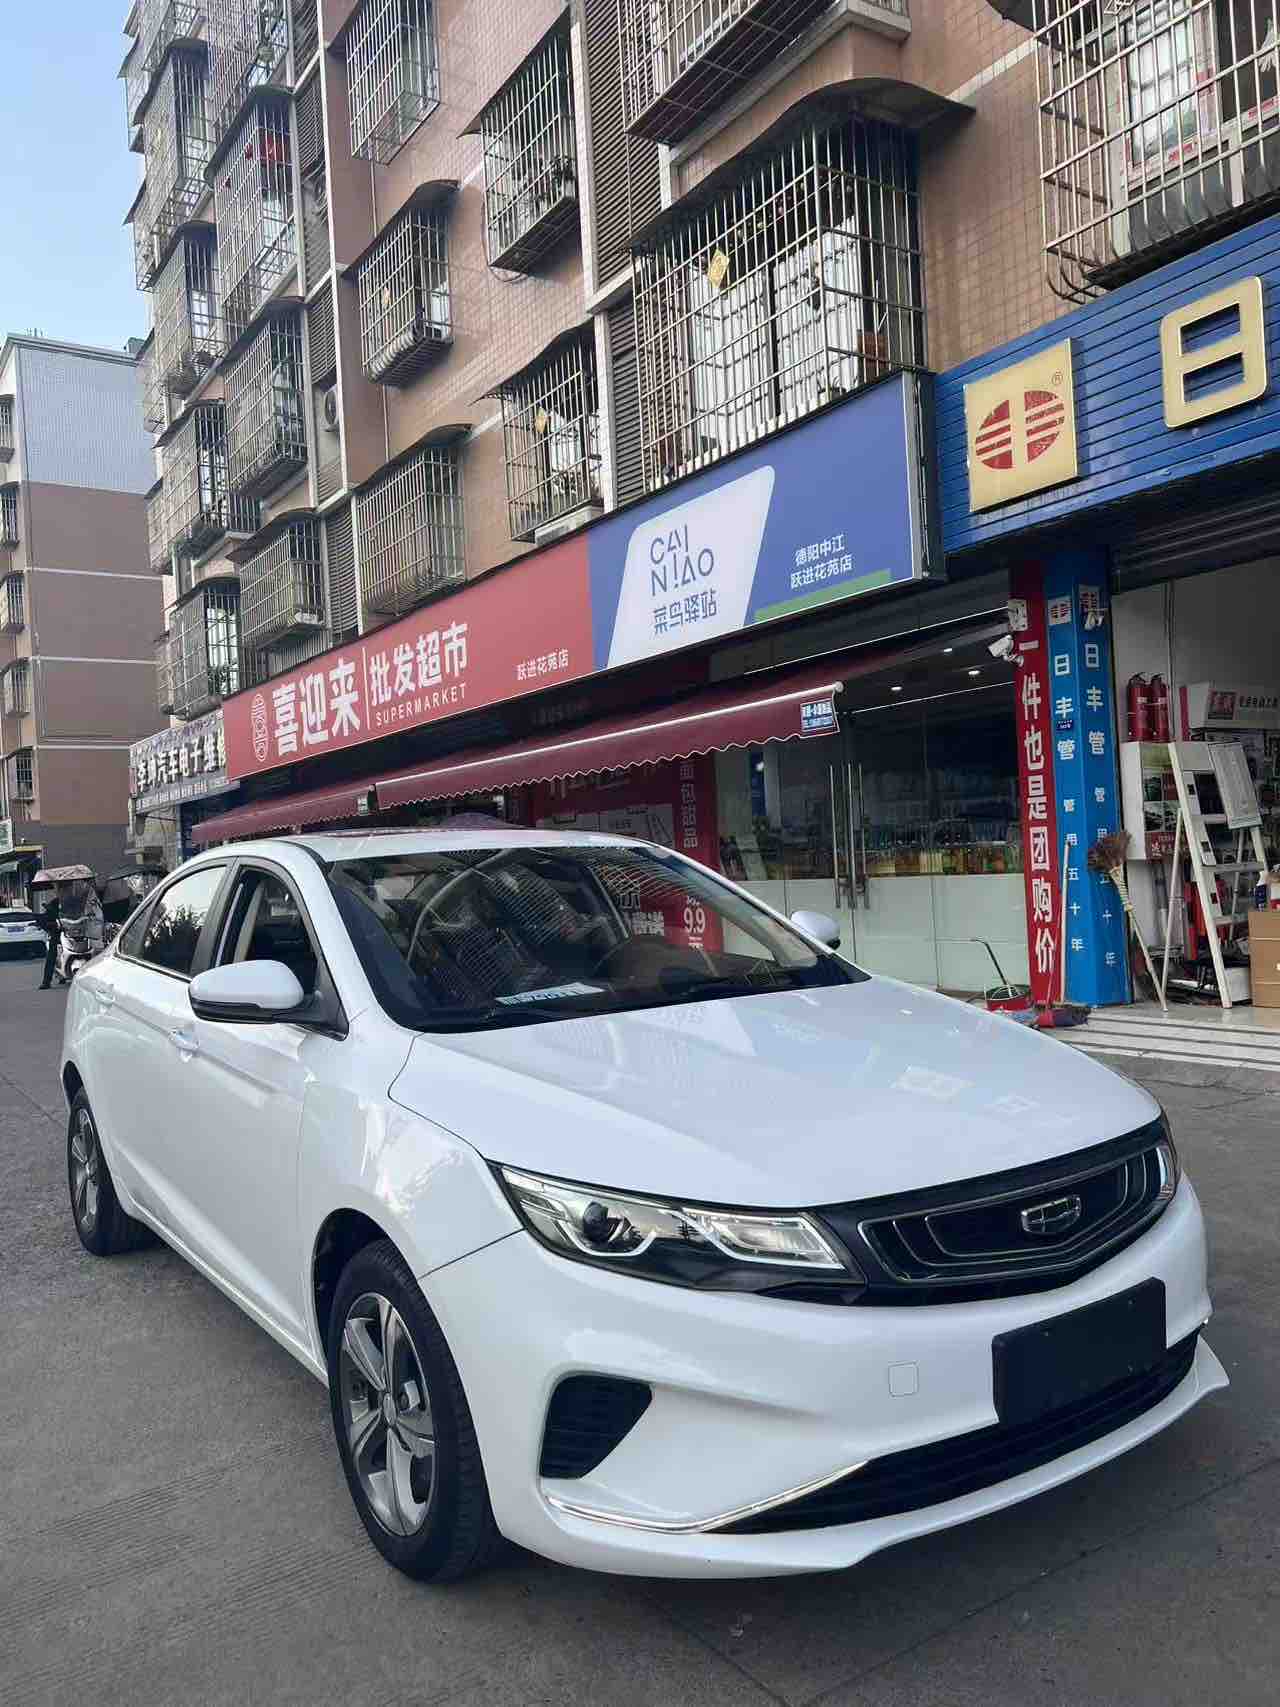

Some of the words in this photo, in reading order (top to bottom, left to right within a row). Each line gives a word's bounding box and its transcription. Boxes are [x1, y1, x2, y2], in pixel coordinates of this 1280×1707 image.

[1160, 276, 1268, 429] 日
[650, 524, 689, 565] CAI
[794, 532, 846, 569] 德阳中江
[790, 552, 854, 590] 跃进花苑店
[652, 589, 718, 636] 菜鸟驿站
[369, 621, 468, 707] 批发超市
[516, 646, 569, 681] 跃进花苑店
[272, 657, 361, 758] 喜迎来
[376, 682, 467, 727] SUPERMARKET
[1054, 653, 1076, 761] 日丰管
[1085, 643, 1105, 756] 日丰管
[1018, 640, 1057, 974] 一件也是团购价
[683, 906, 706, 933] 9.9
